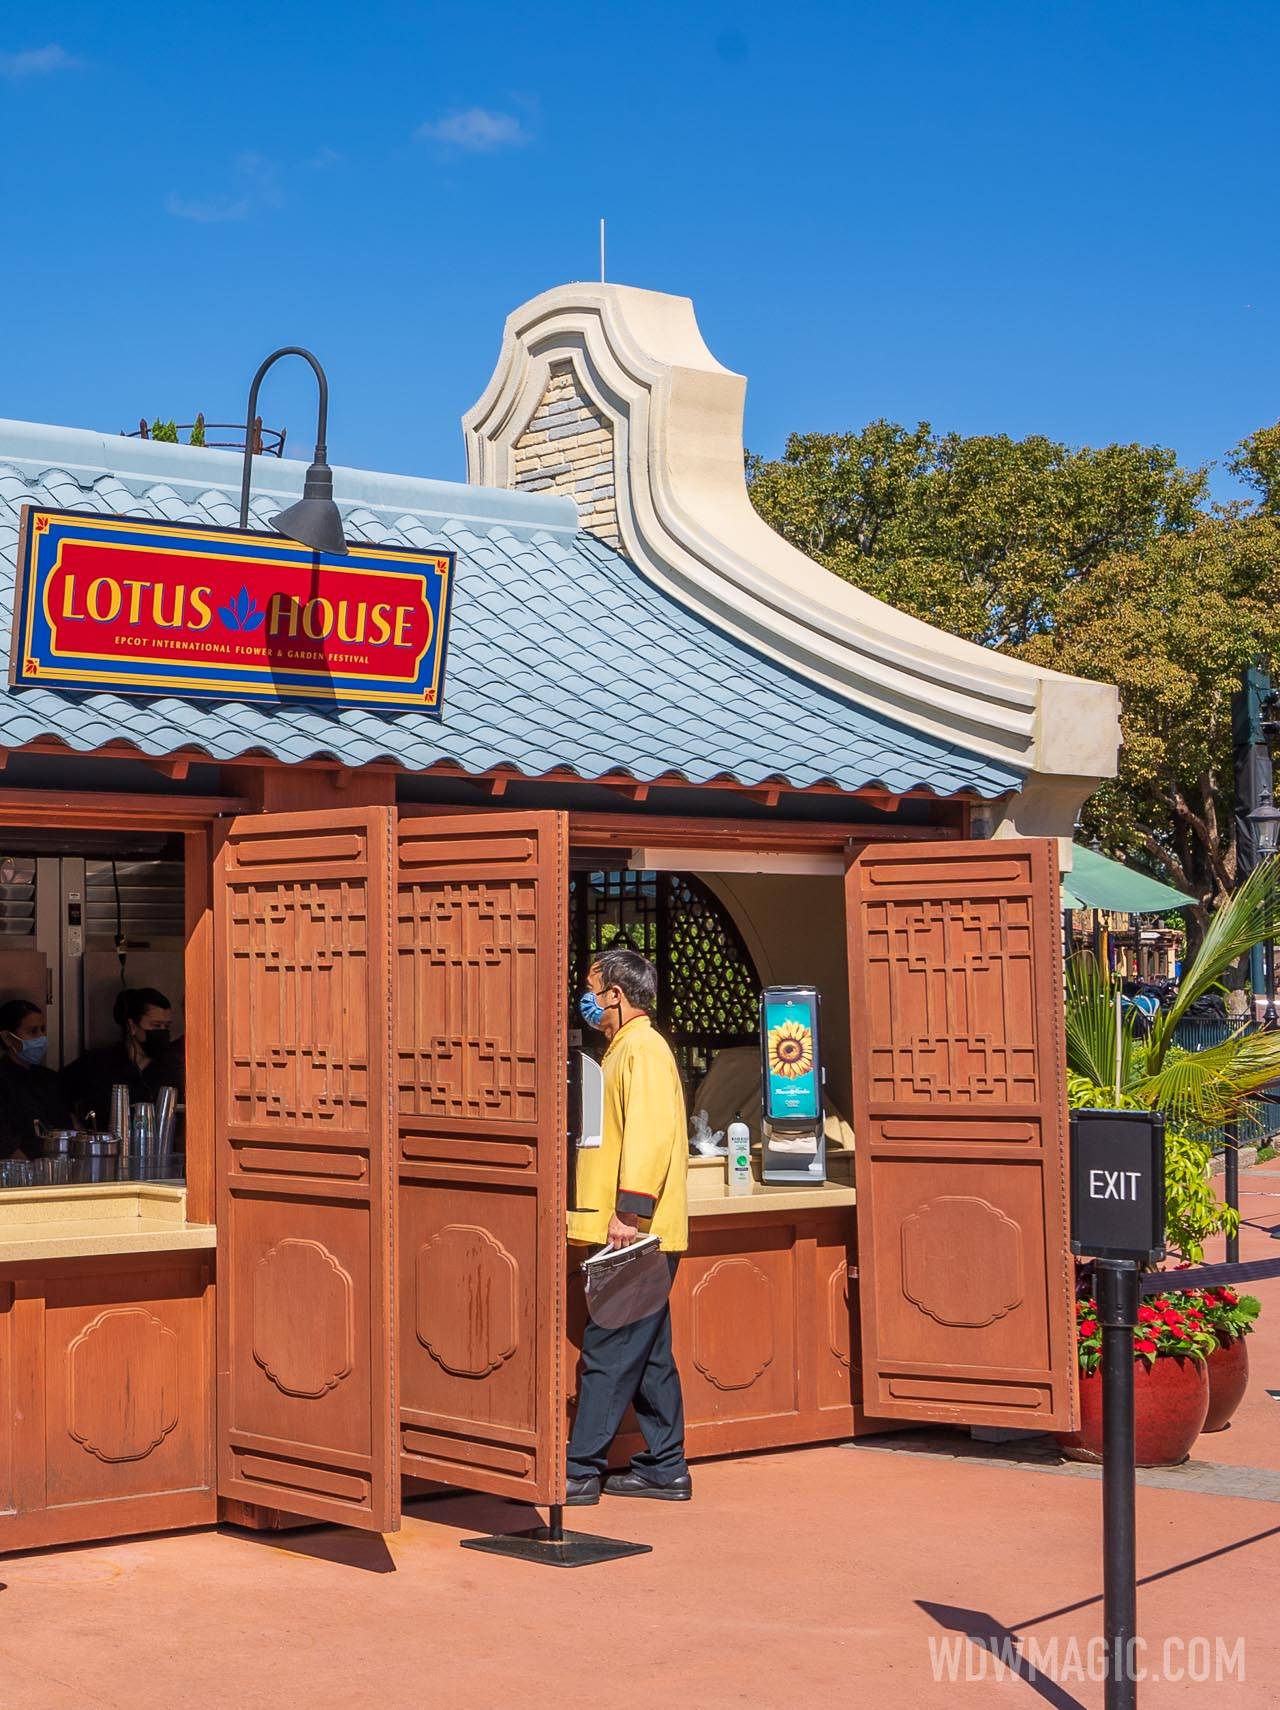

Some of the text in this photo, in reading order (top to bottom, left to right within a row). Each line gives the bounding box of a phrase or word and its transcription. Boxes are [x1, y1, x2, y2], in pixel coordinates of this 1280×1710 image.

[62, 574, 415, 647] LOTUS HOUSE
[114, 636, 369, 664] EPCOT INTERNATIONAL FLOWER & GARDEN FESTIVAL
[1089, 1169, 1142, 1201] EXIT
